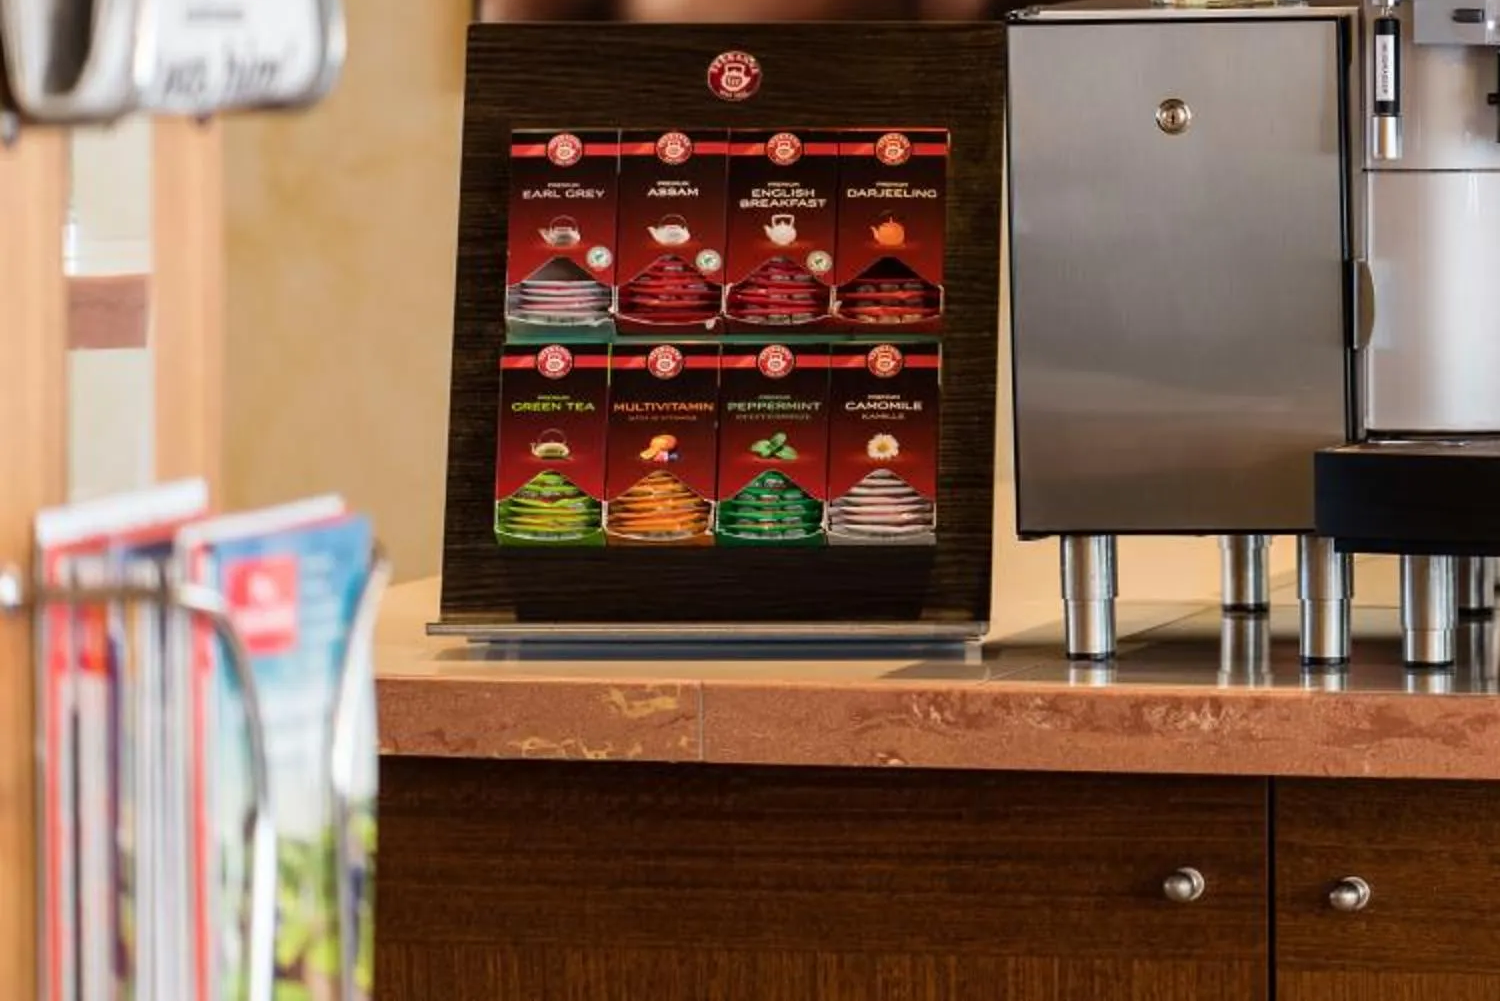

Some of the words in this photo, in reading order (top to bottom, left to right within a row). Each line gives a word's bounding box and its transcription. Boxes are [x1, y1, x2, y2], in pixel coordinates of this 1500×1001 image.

[521, 189, 561, 200] EARL
[564, 187, 606, 199] GREY
[646, 187, 700, 197] ASSAM
[751, 188, 816, 198] ENGLISH
[846, 188, 938, 199] DARJEELING
[739, 198, 828, 209] BREAKFAST
[511, 401, 561, 412] GREEN
[566, 401, 596, 412] TEA
[612, 401, 716, 412] MULTIVITAMIN
[726, 401, 823, 412] PEPPERMINT
[844, 401, 924, 412] CAMOMILE
